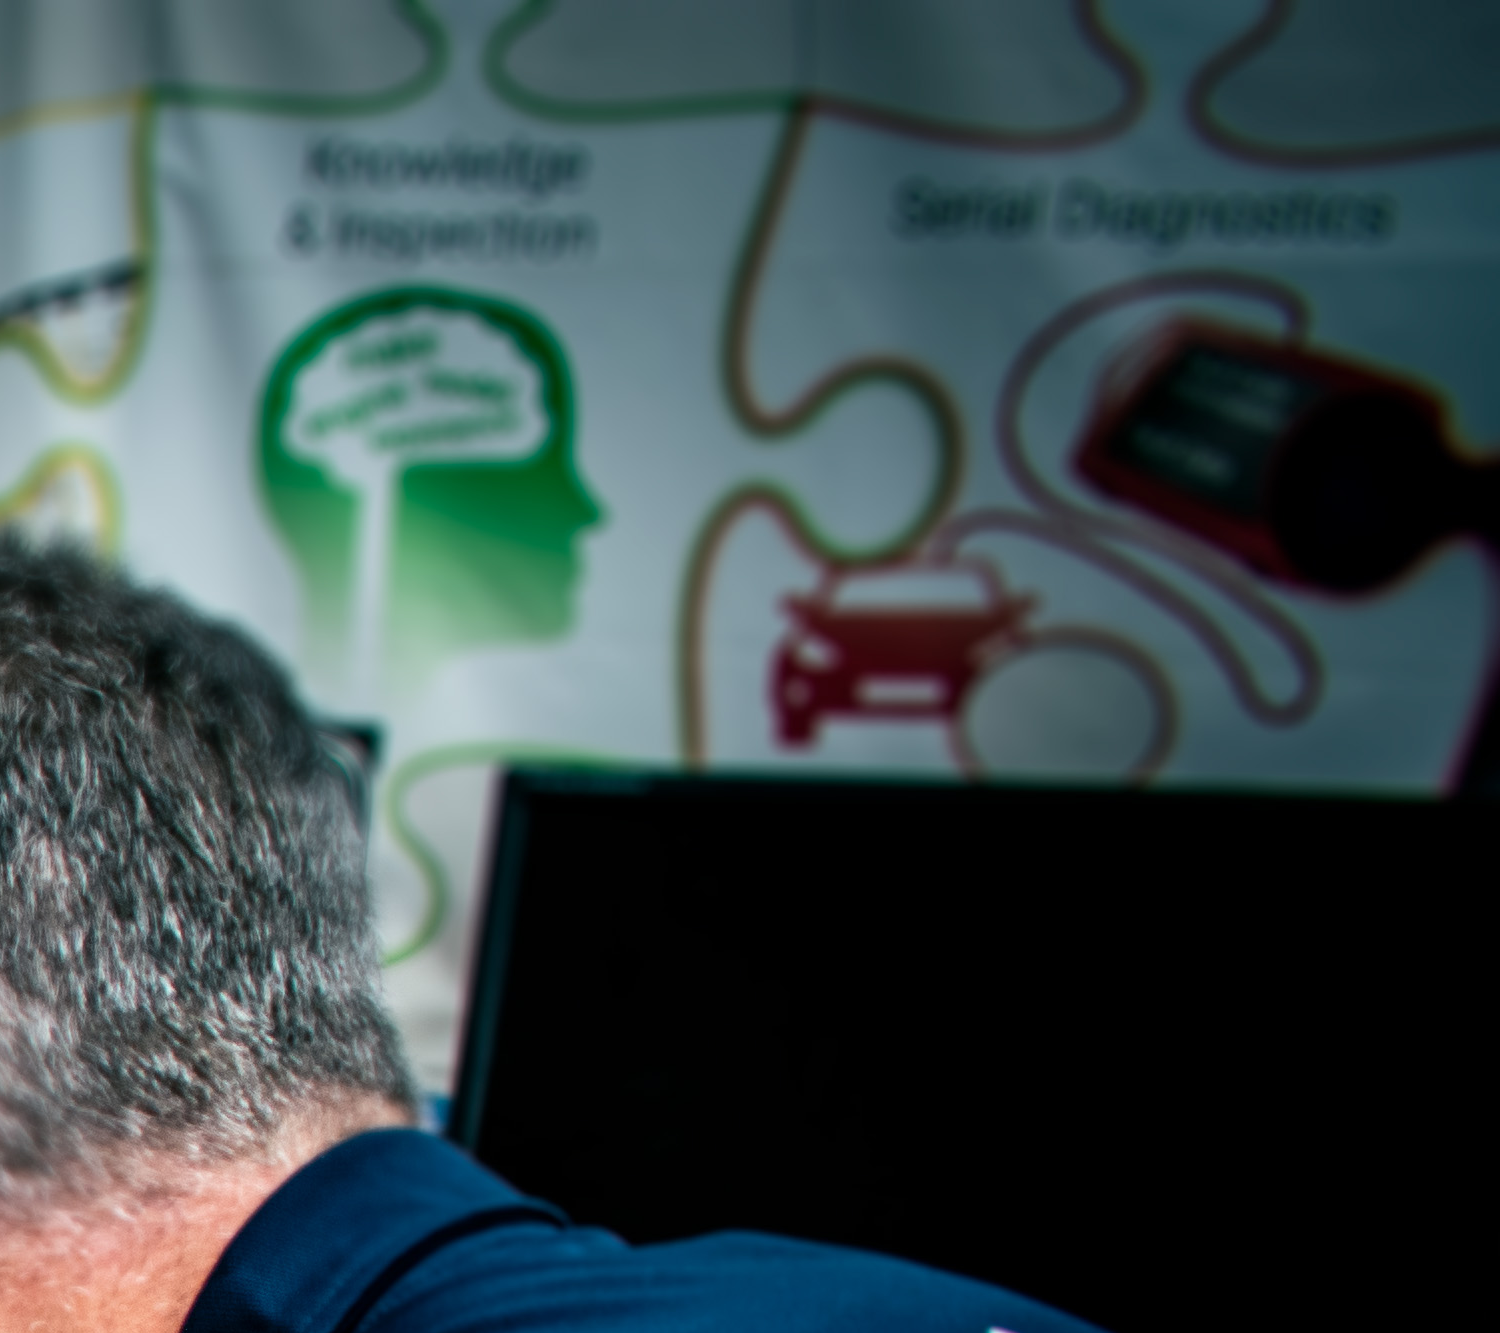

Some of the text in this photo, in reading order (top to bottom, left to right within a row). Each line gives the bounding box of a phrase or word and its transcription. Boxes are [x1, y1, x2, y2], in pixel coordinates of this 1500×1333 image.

[305, 138, 591, 202] Knowledge
[285, 207, 596, 262] & Inspection
[895, 178, 1393, 249] Serial Diagnostics
